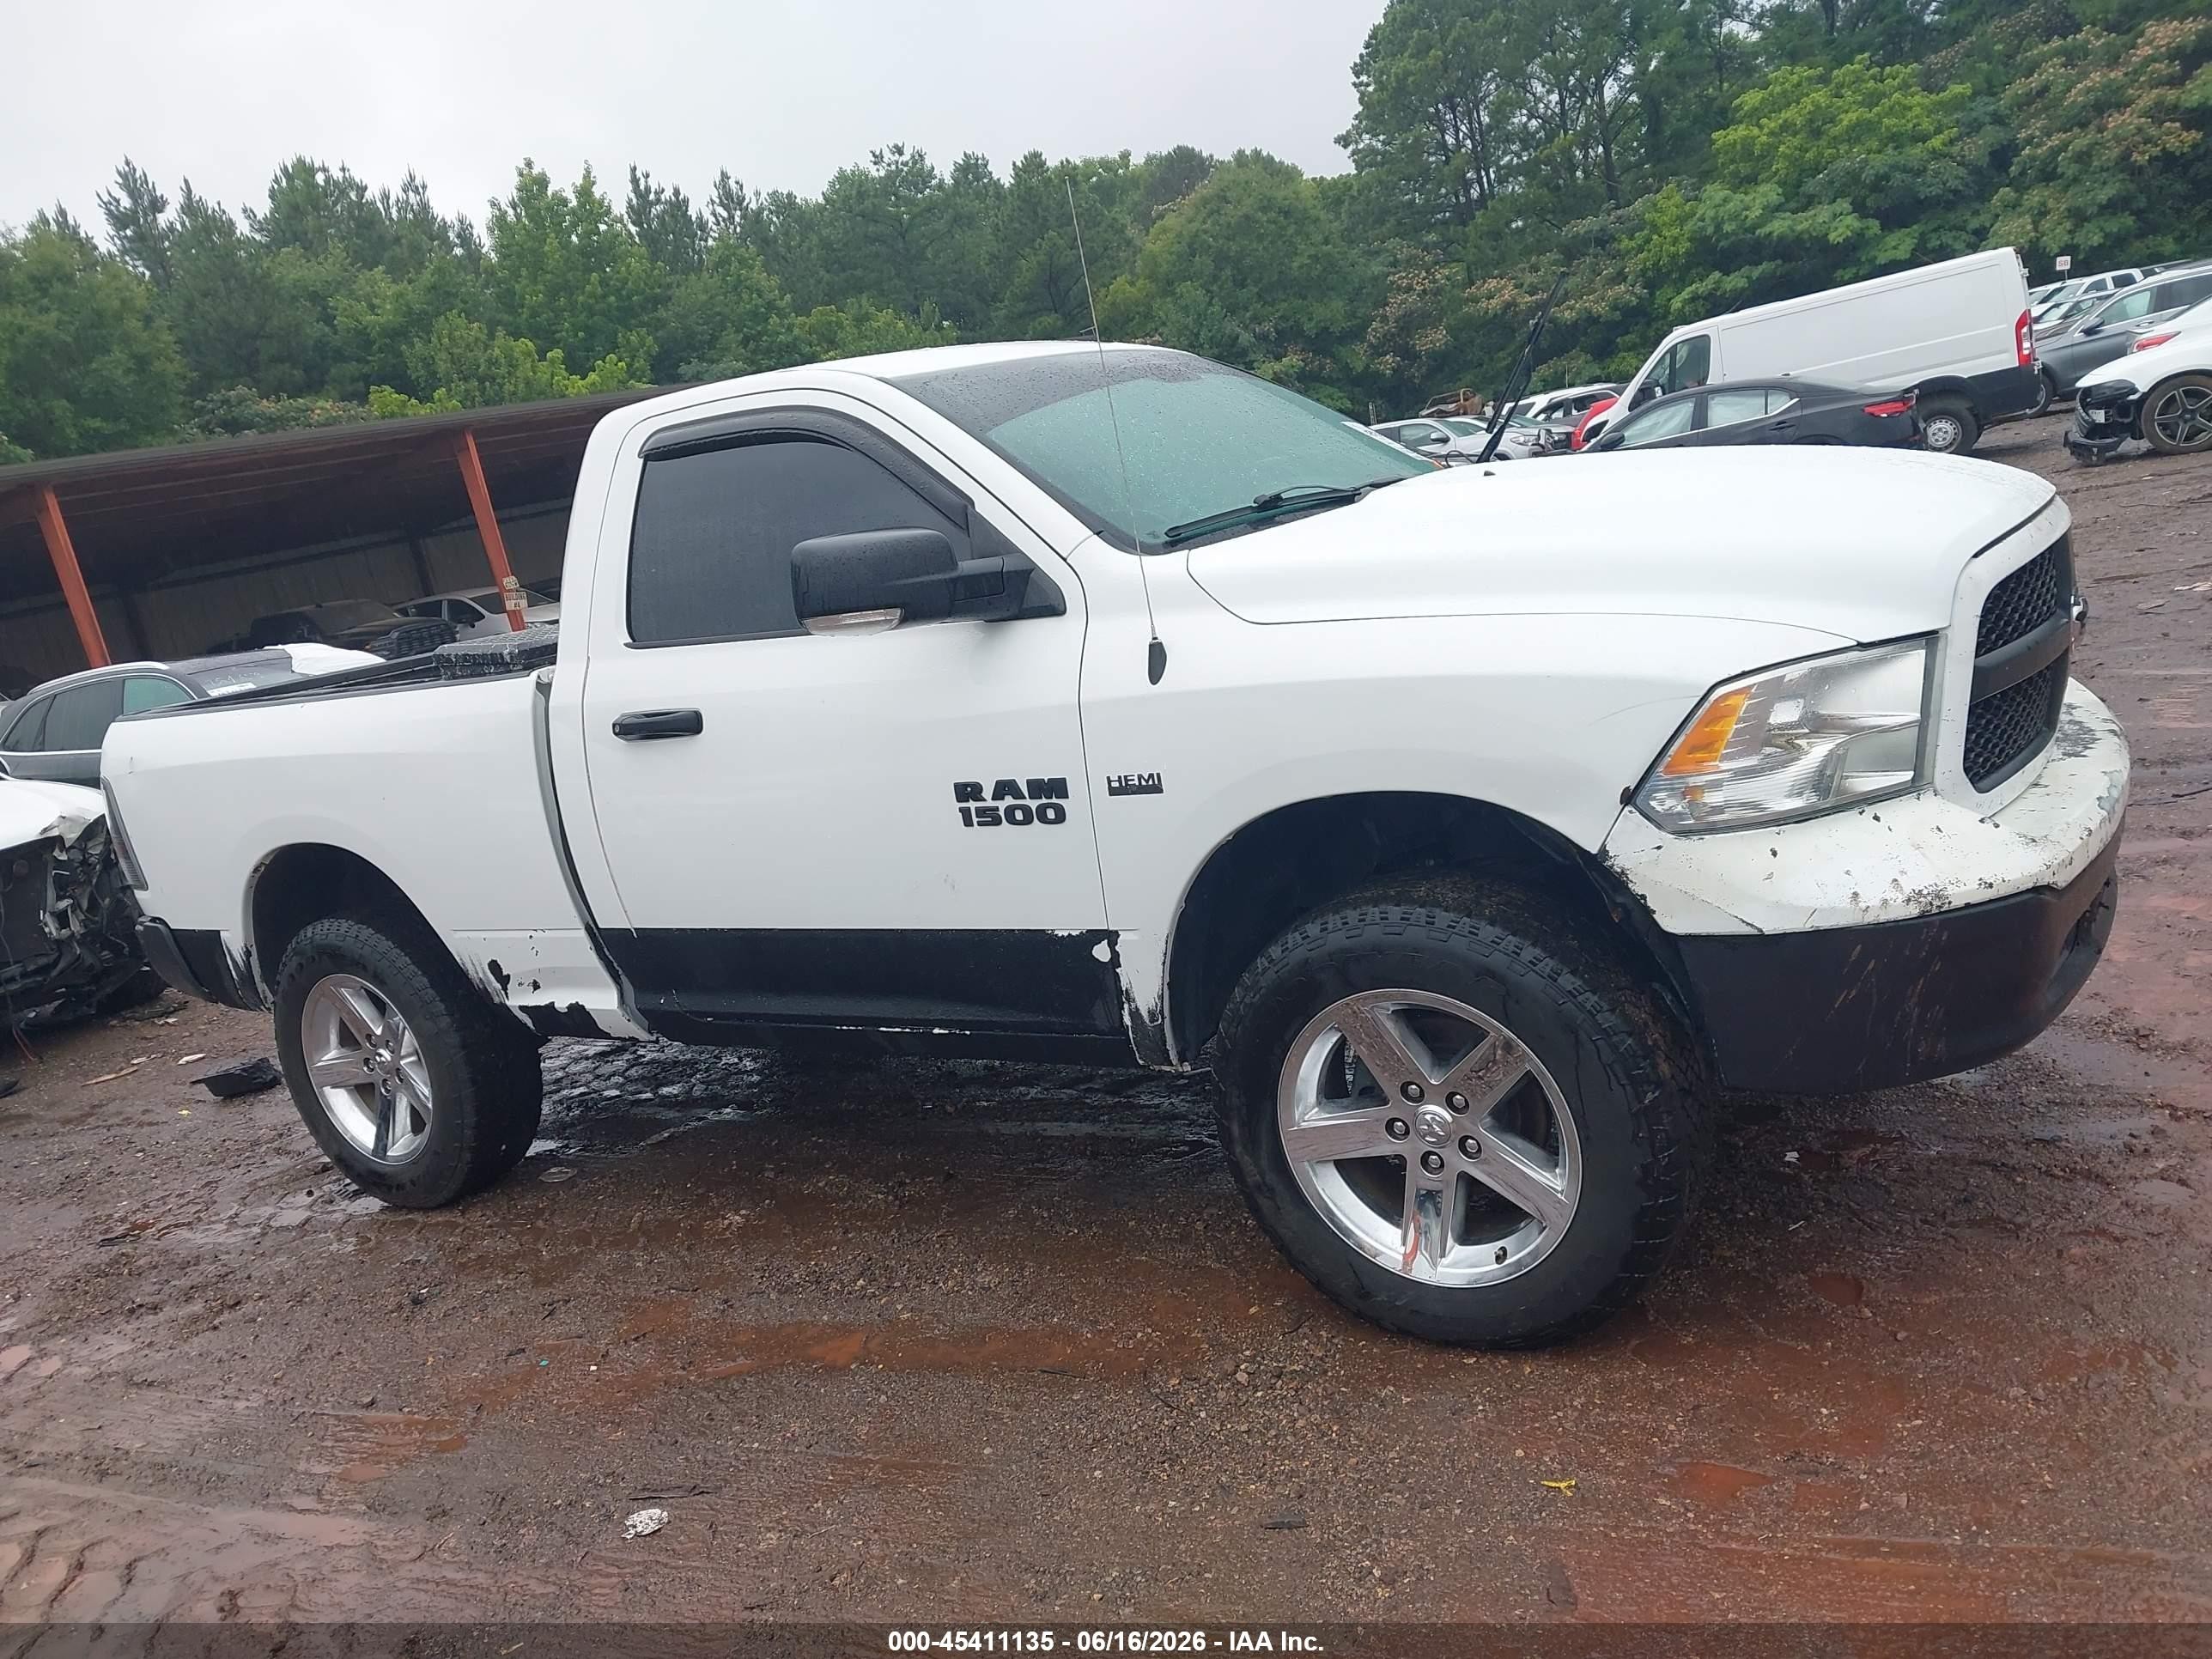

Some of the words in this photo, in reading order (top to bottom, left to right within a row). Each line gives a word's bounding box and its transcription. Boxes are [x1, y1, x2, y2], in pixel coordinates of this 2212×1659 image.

[953, 777, 1070, 803] RAM
[1106, 772, 1163, 790] HEMI
[958, 802, 1067, 827] 1500
